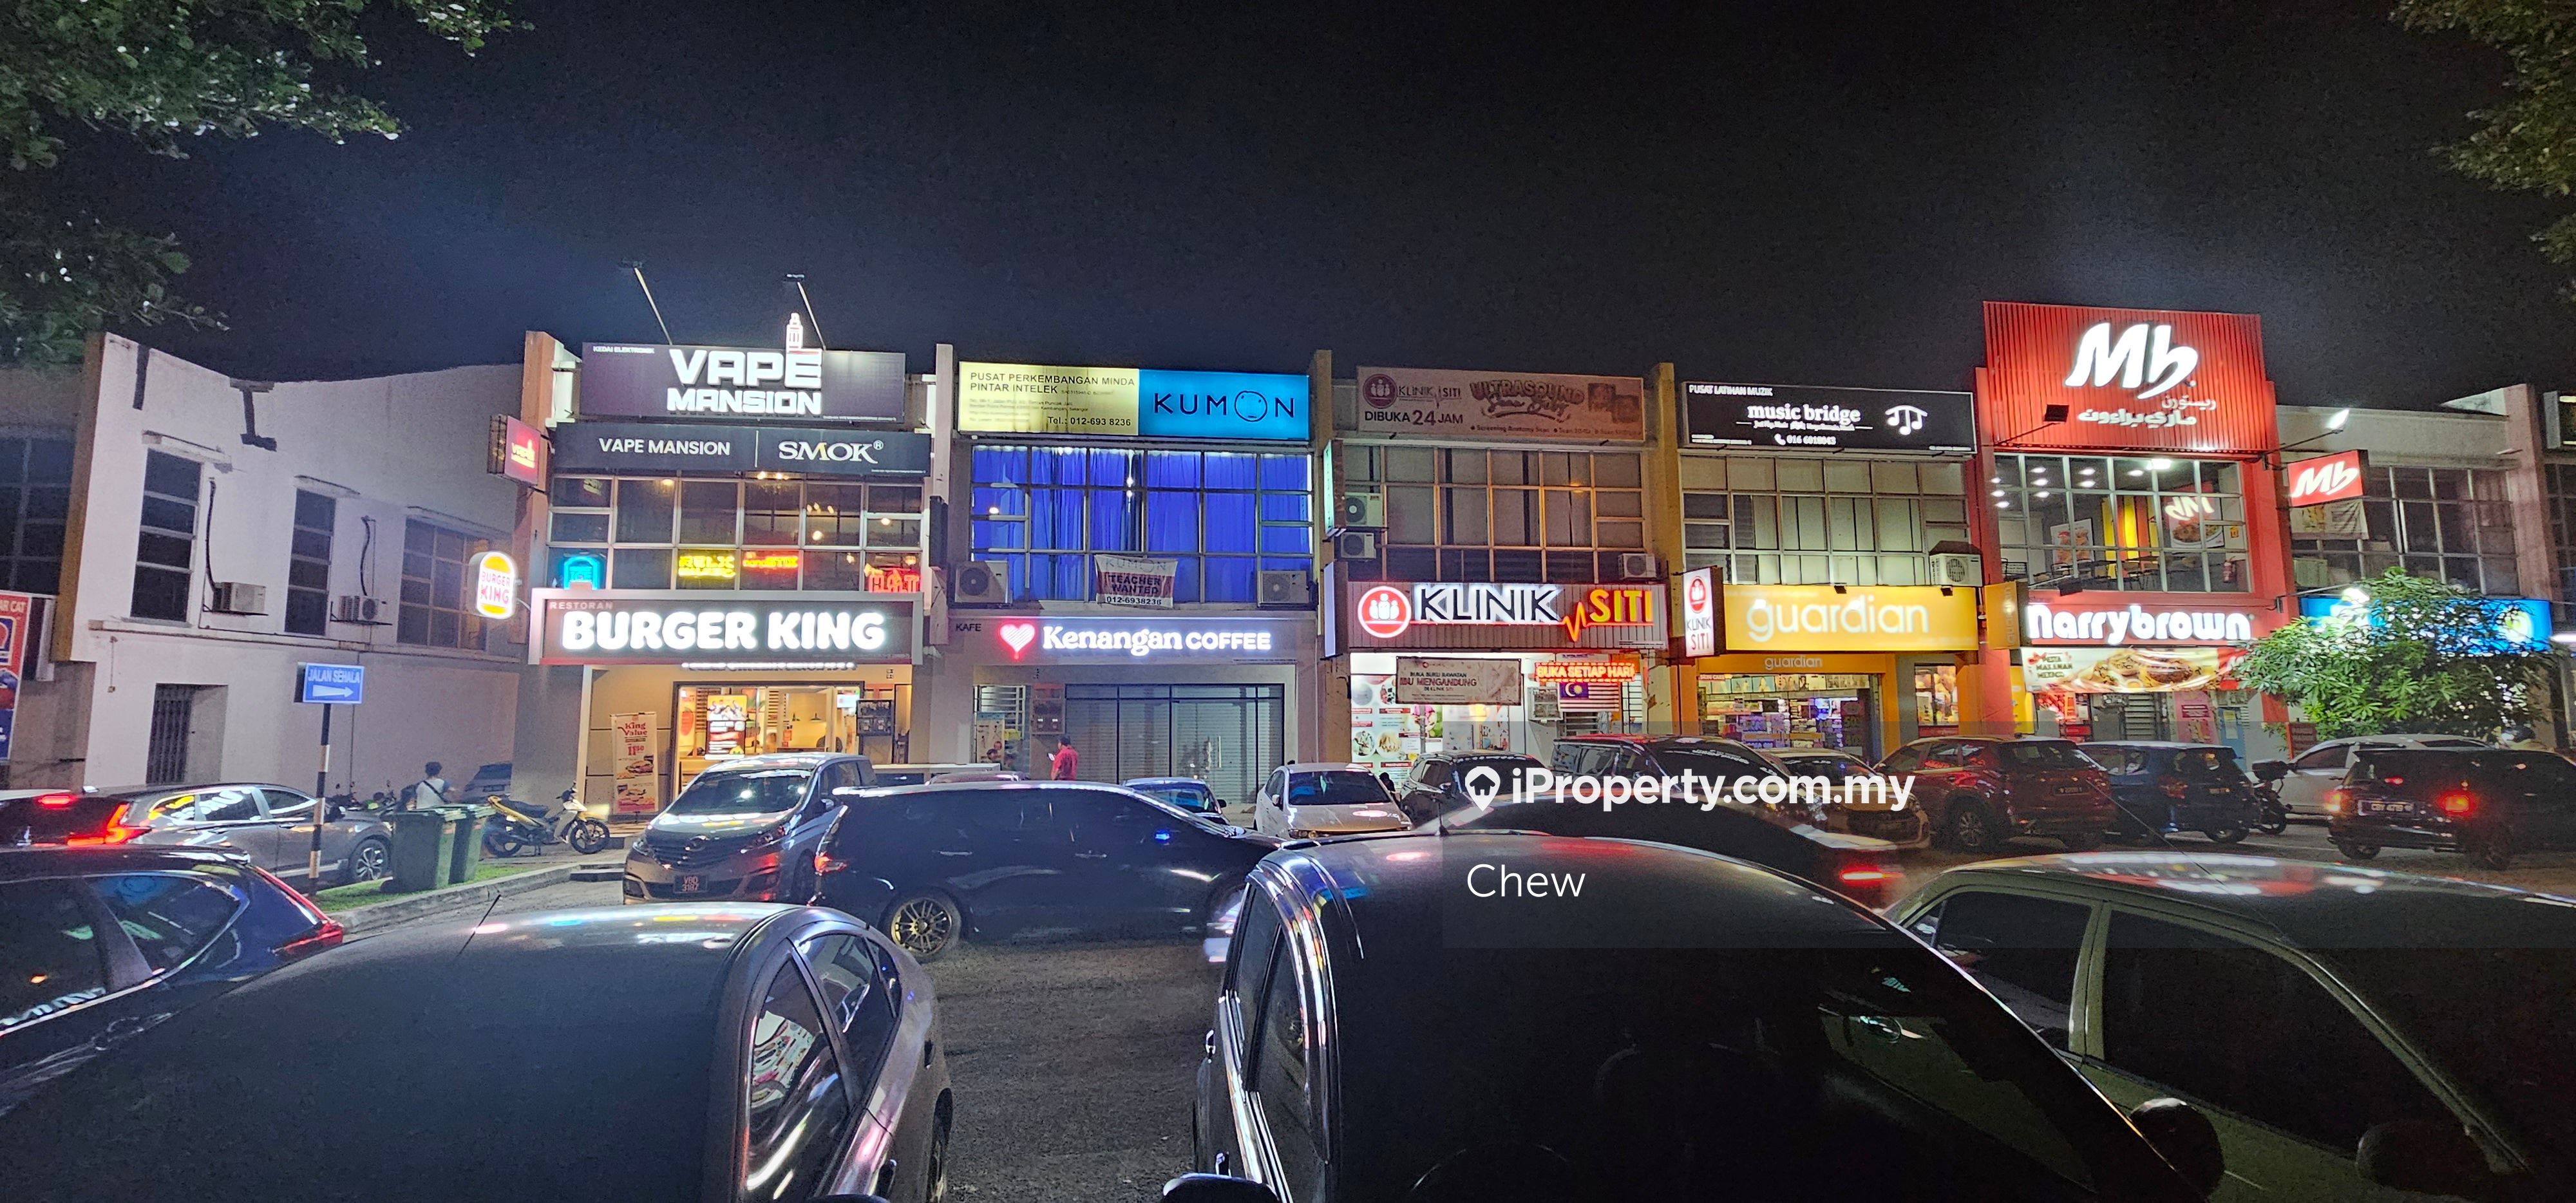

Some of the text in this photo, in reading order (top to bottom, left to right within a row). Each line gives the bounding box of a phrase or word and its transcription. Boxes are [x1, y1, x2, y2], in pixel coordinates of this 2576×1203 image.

[669, 348, 822, 388] VAPE
[971, 372, 1135, 385] PUSAT PERKEMBANGAN MINDA
[971, 383, 1009, 392] PINTAR
[1012, 384, 1057, 393] INTELEK
[1399, 386, 1461, 397] KLINIK SITI
[1469, 379, 1585, 405] ULTRASOUND
[667, 388, 822, 415] MANSION
[1154, 390, 1294, 422] KUMON
[1365, 410, 1463, 426] DIBUKA 24 JAM
[1747, 403, 1801, 421] music
[1803, 404, 1861, 426] bridge
[600, 439, 730, 455] VAPE MANSION
[1106, 558, 1166, 573] KUMON
[481, 571, 511, 587] BURGER
[1109, 574, 1160, 586] TEACHER
[480, 583, 509, 604] KING
[1112, 584, 1159, 594] WANTED
[1106, 596, 1162, 605] 012-6938236
[1417, 585, 1654, 623] KLINIK SITI
[1687, 616, 1712, 631] KLINIK
[1747, 595, 1929, 642] guardian
[562, 611, 886, 650] BURGER KING
[955, 623, 982, 632] KAFE
[1043, 626, 1272, 656] Kenangan COFFEE
[1691, 632, 1709, 650] SITI
[1764, 654, 1823, 671] guardian
[308, 668, 360, 683] JALAN SEHALA
[1537, 666, 1635, 678] BUKA SETIAP HARI
[1417, 677, 1477, 687] MENGANDUNG
[618, 727, 648, 736] Value
